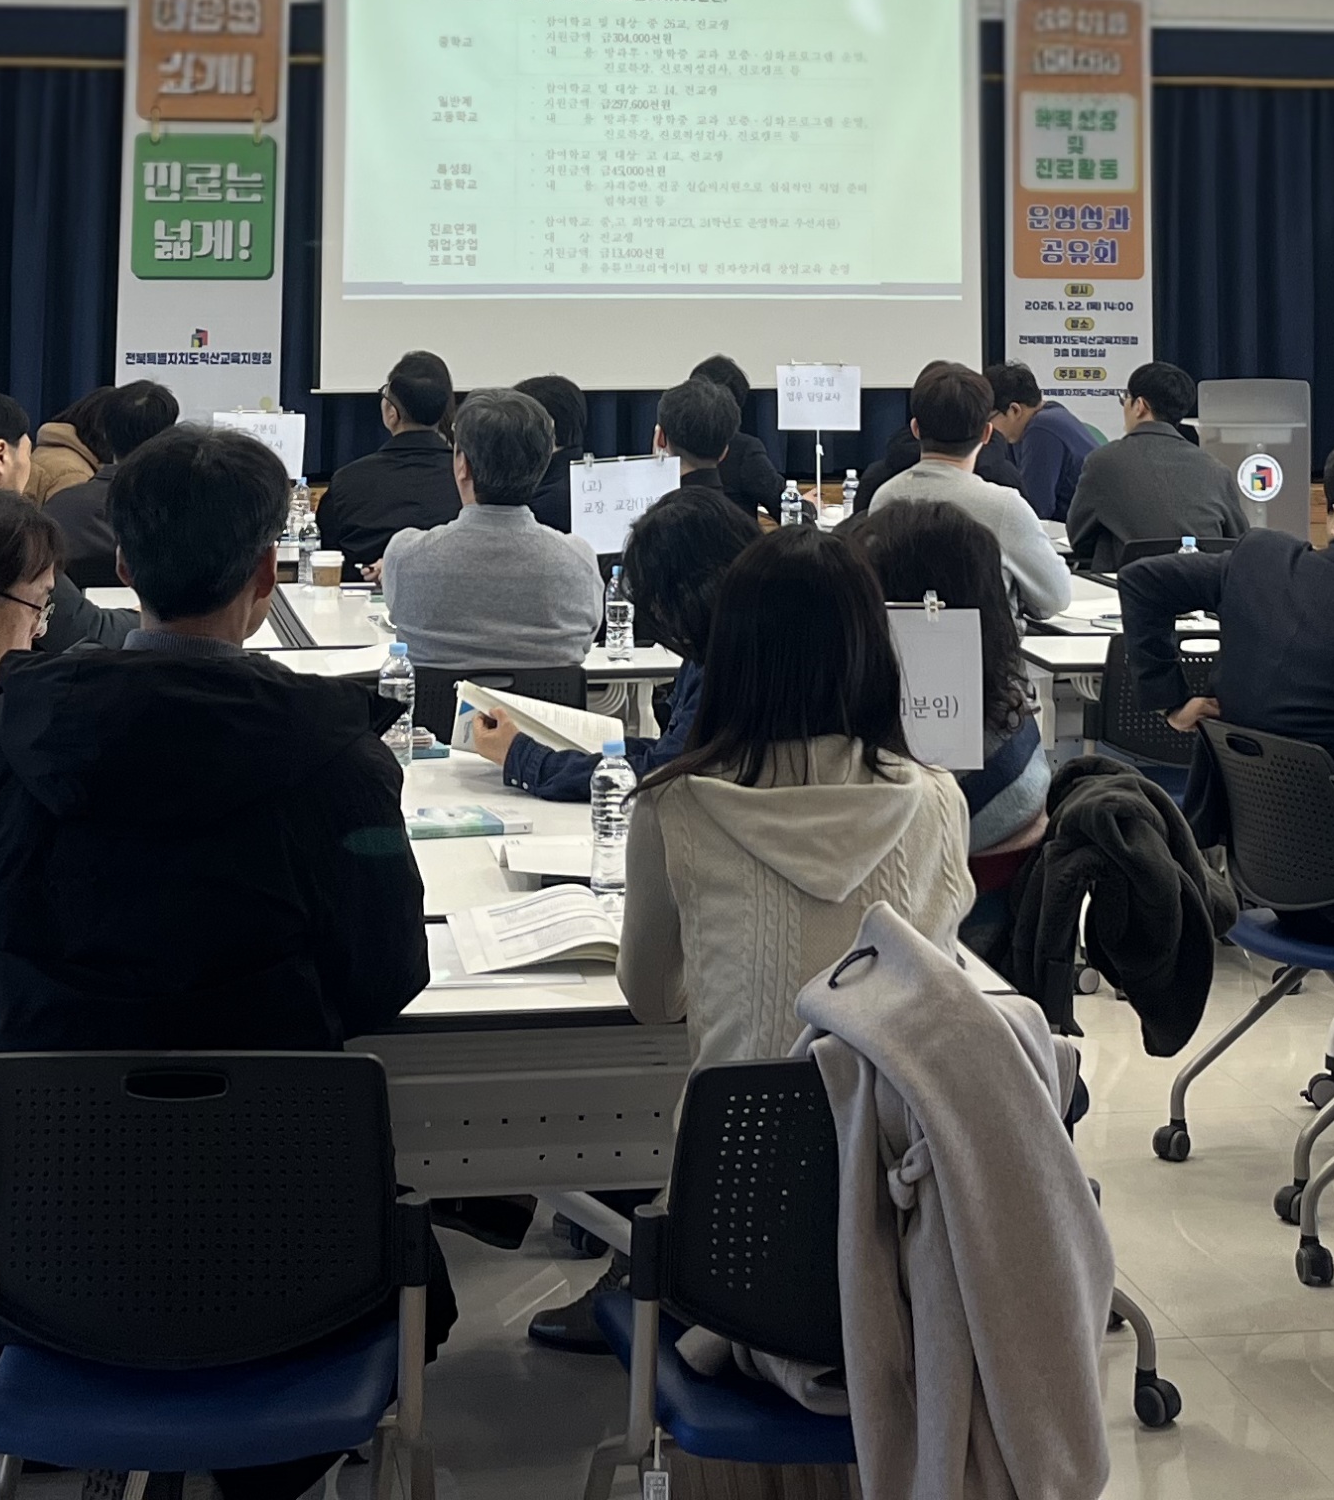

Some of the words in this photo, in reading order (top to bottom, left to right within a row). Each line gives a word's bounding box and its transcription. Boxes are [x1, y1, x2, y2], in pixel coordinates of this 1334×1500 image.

[1035, 157, 1119, 180] 진로활동
[154, 219, 251, 260] 넓게!
[1041, 237, 1118, 266] 공유회
[1103, 301, 1134, 311] 14:00
[581, 480, 603, 494] (고)
